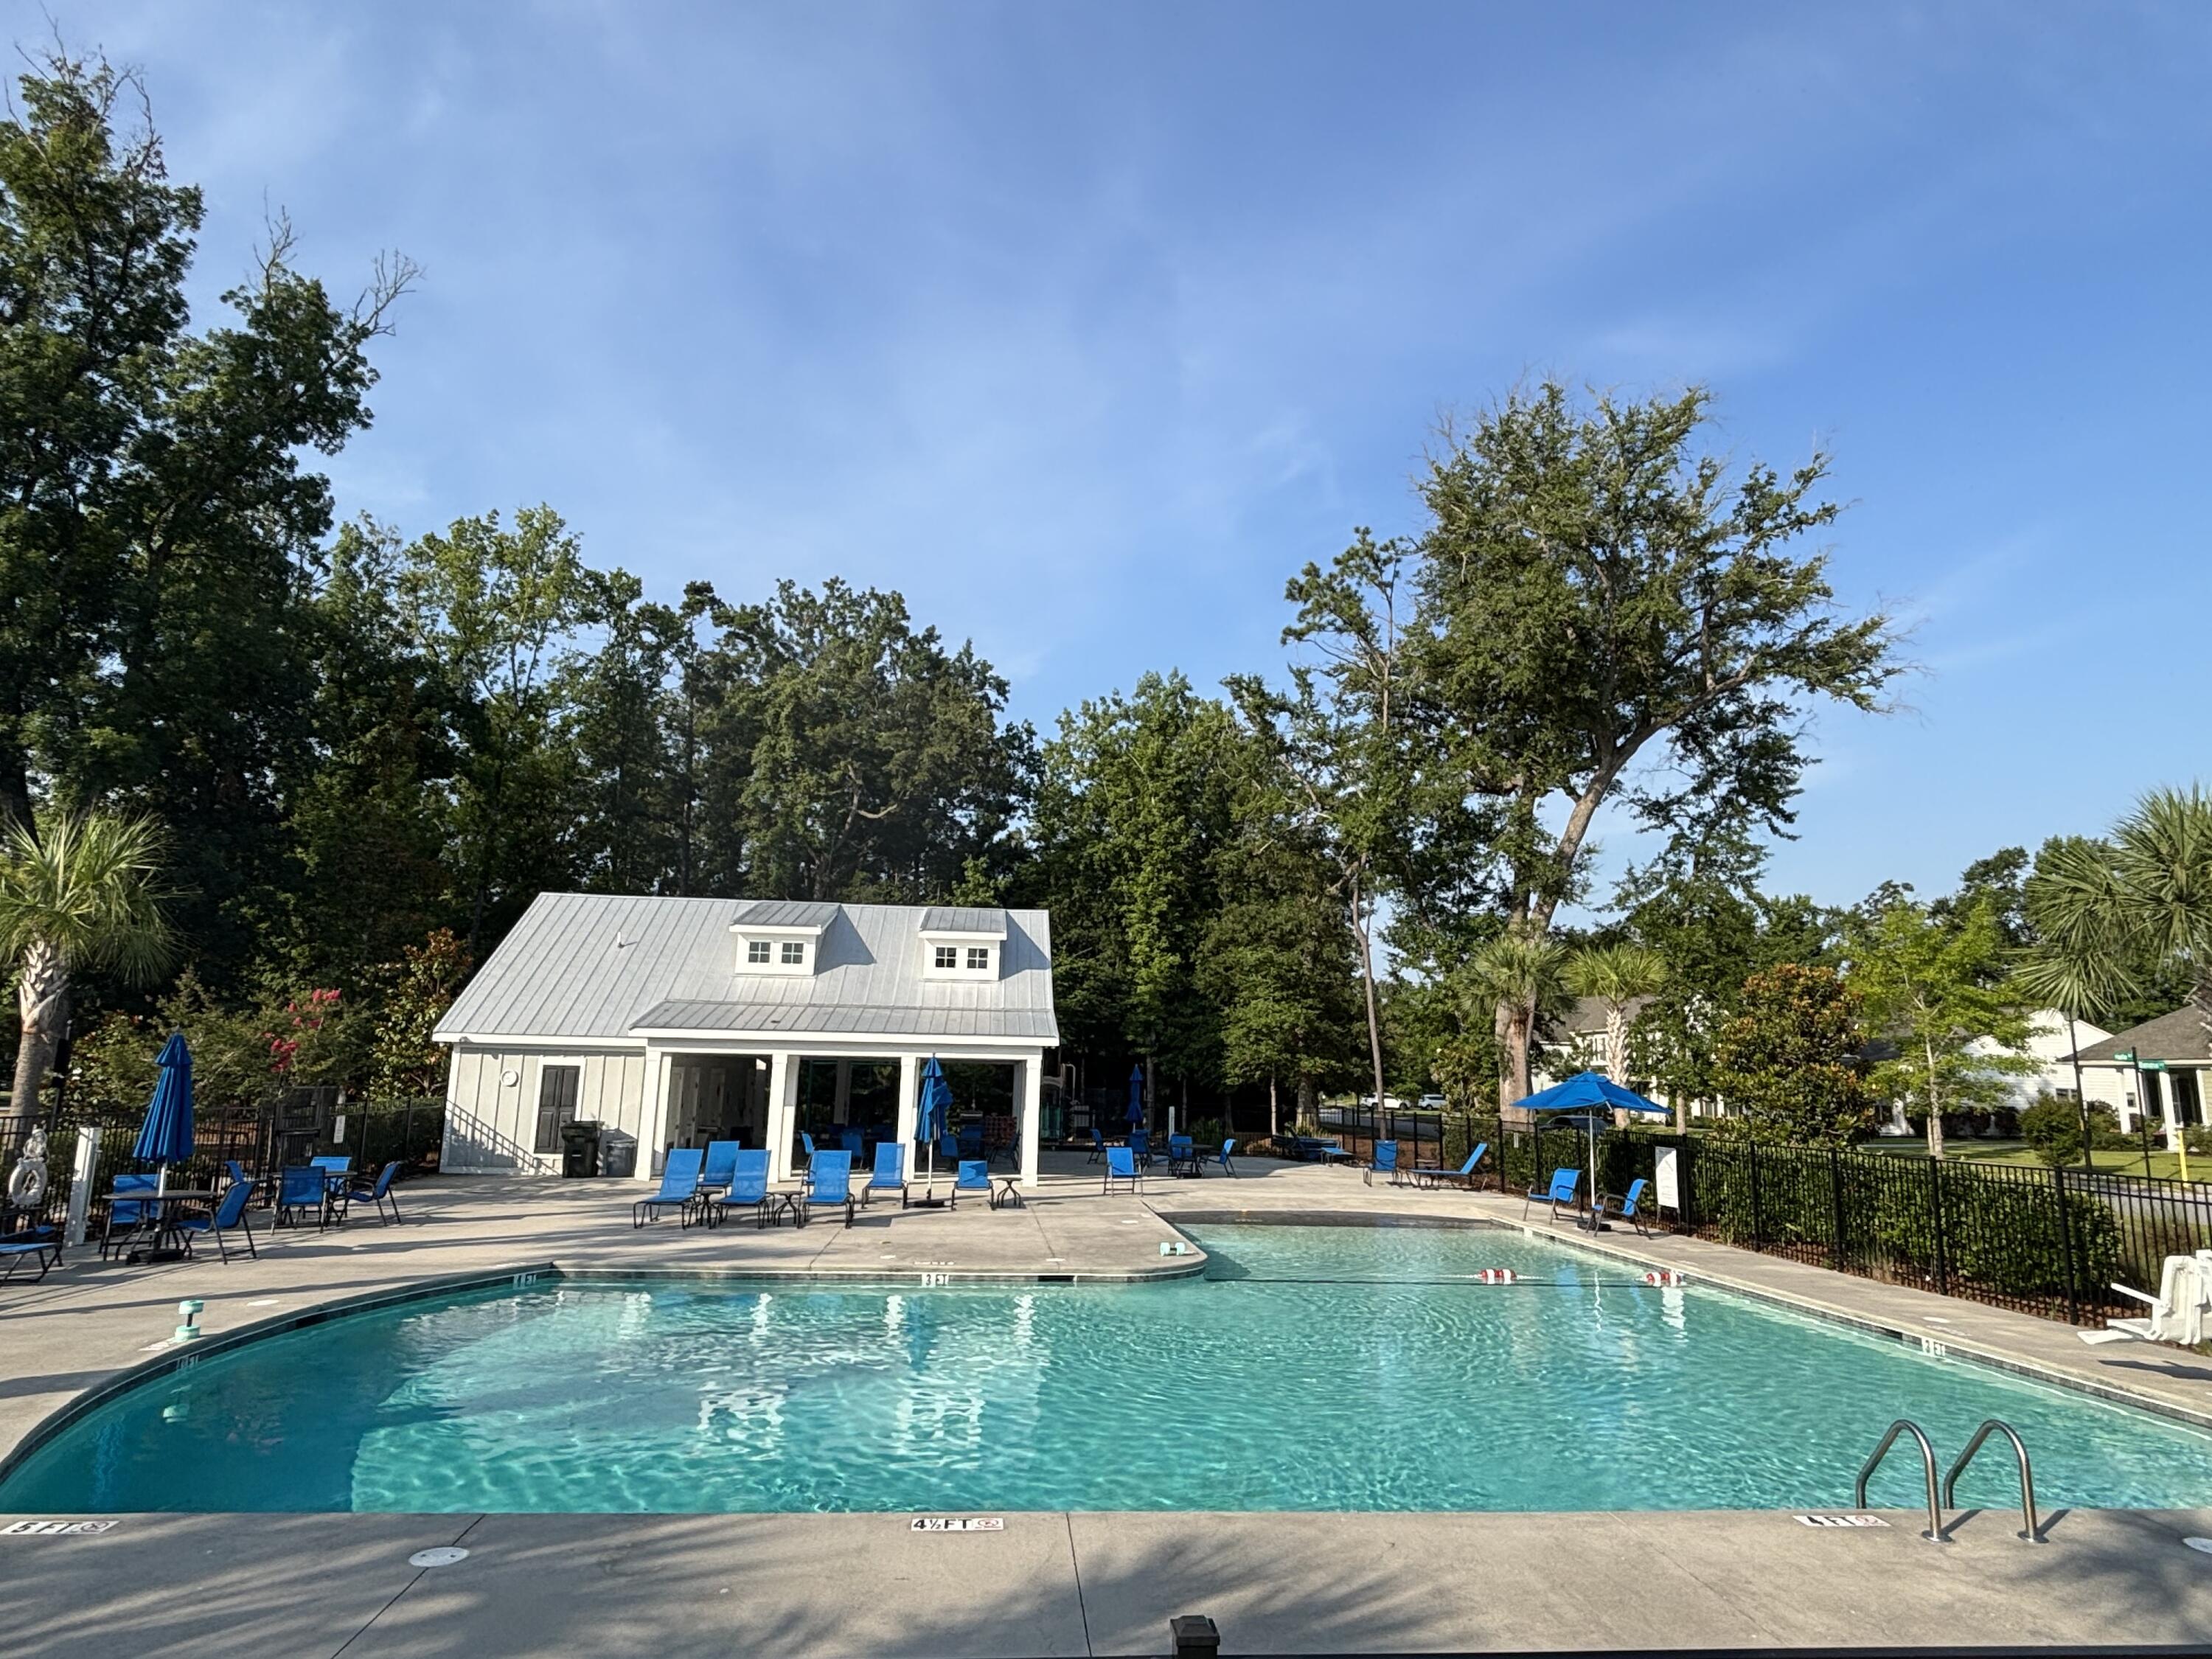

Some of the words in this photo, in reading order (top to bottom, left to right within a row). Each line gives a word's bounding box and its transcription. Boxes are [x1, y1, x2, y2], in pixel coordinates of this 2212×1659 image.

[10, 1522, 40, 1533] 5
[36, 1521, 83, 1533] FT
[943, 1518, 973, 1530] FT
[1824, 1516, 1857, 1526] FT
